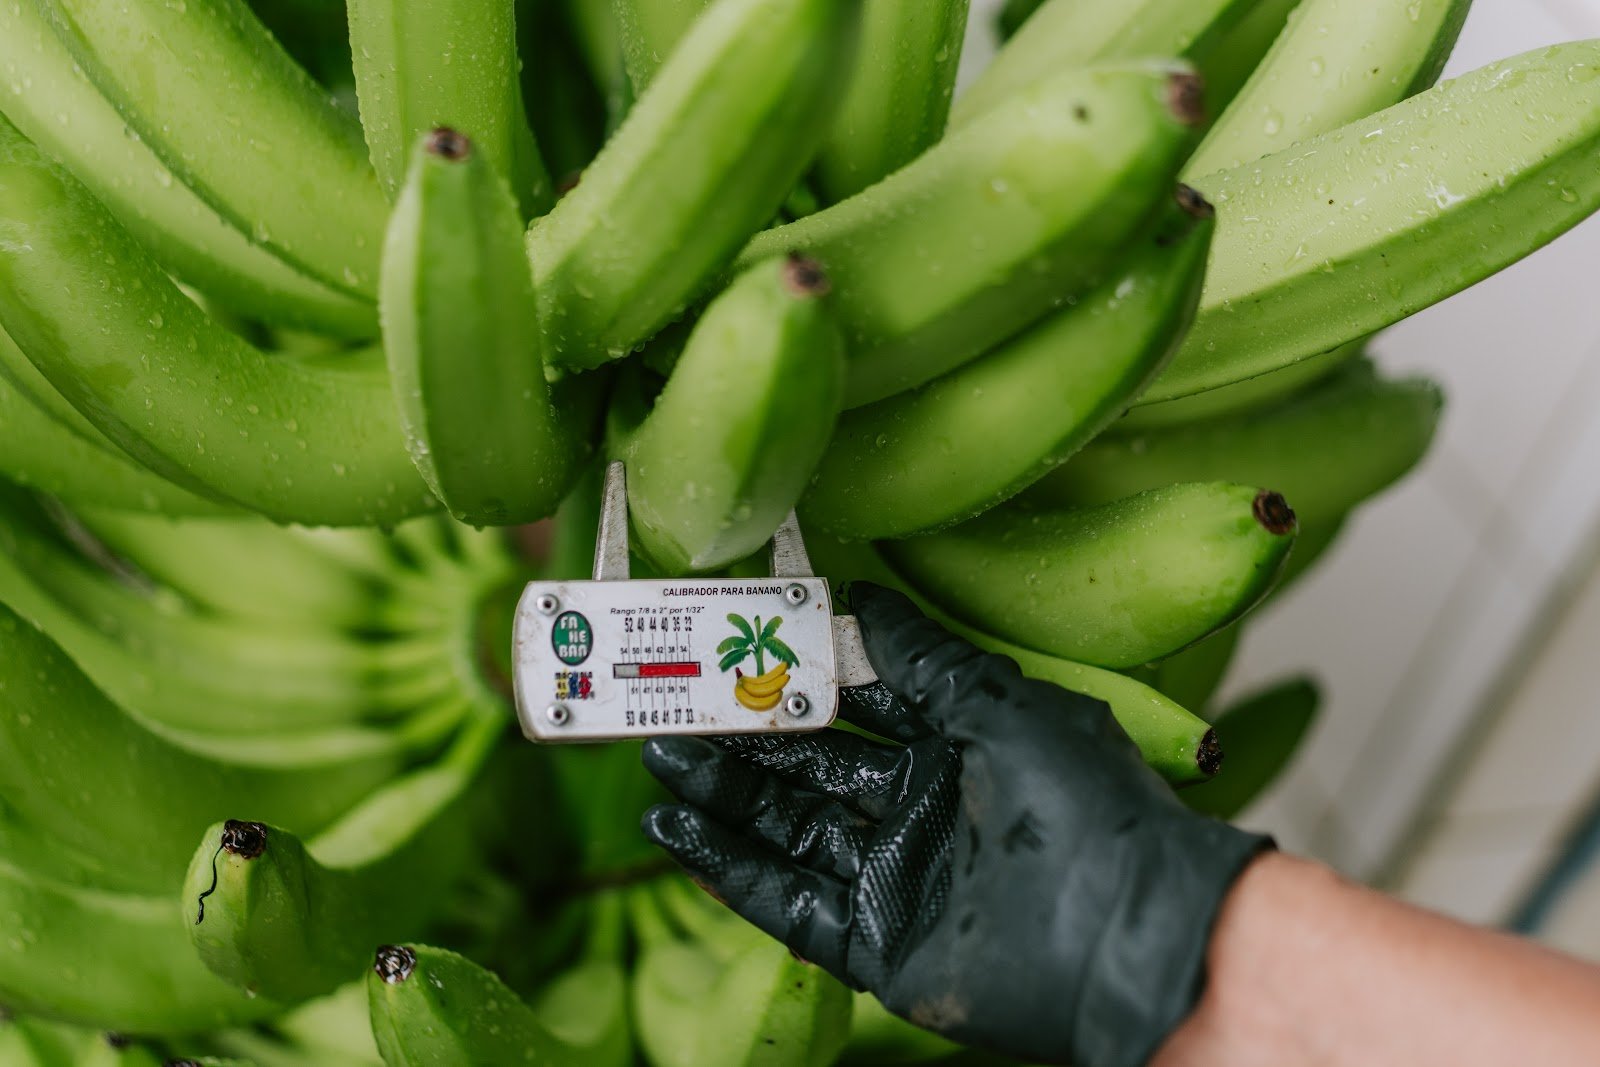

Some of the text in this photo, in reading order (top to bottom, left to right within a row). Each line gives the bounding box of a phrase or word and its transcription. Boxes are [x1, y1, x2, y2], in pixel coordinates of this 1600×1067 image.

[662, 586, 782, 596] CALIBRADOR PARA BANANO
[610, 607, 636, 616] Rango
[669, 607, 683, 615] por
[624, 617, 634, 632] 52
[637, 617, 645, 632] 48
[649, 617, 657, 632] 44
[661, 616, 669, 632] 40
[625, 711, 635, 727] 53
[651, 710, 659, 726] 45
[662, 709, 670, 725] 41
[674, 708, 682, 724] 37
[686, 708, 694, 724] 33
